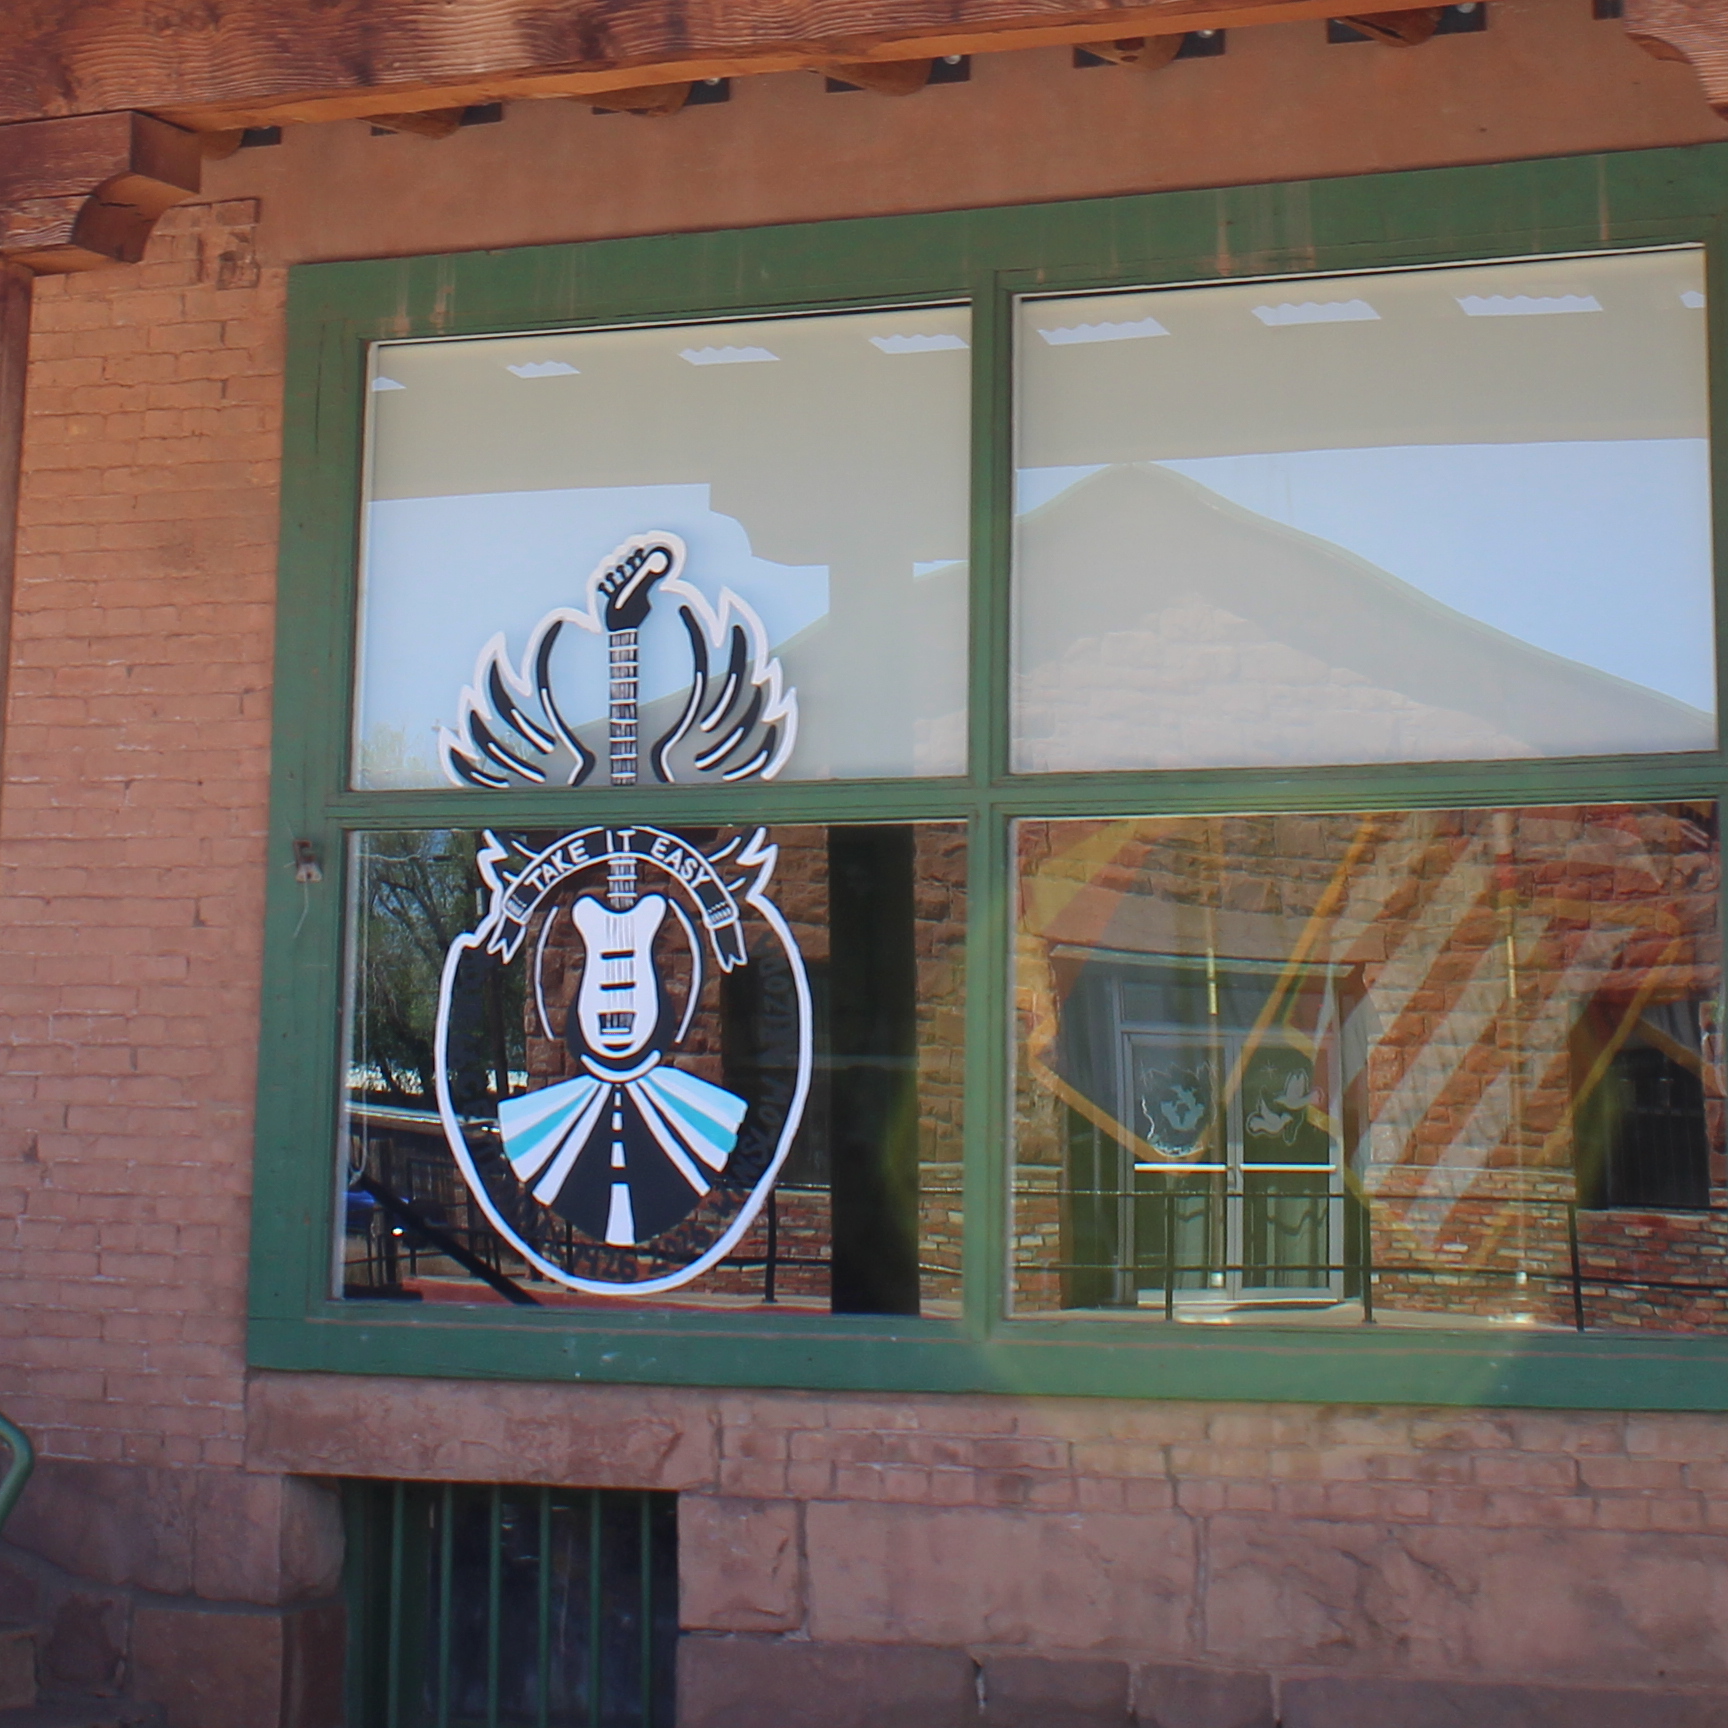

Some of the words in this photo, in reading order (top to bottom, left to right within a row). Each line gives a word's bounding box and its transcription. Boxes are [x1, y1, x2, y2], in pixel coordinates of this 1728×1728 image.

[523, 838, 591, 892] TAKE
[605, 829, 637, 852] IT
[649, 836, 712, 889] EASY
